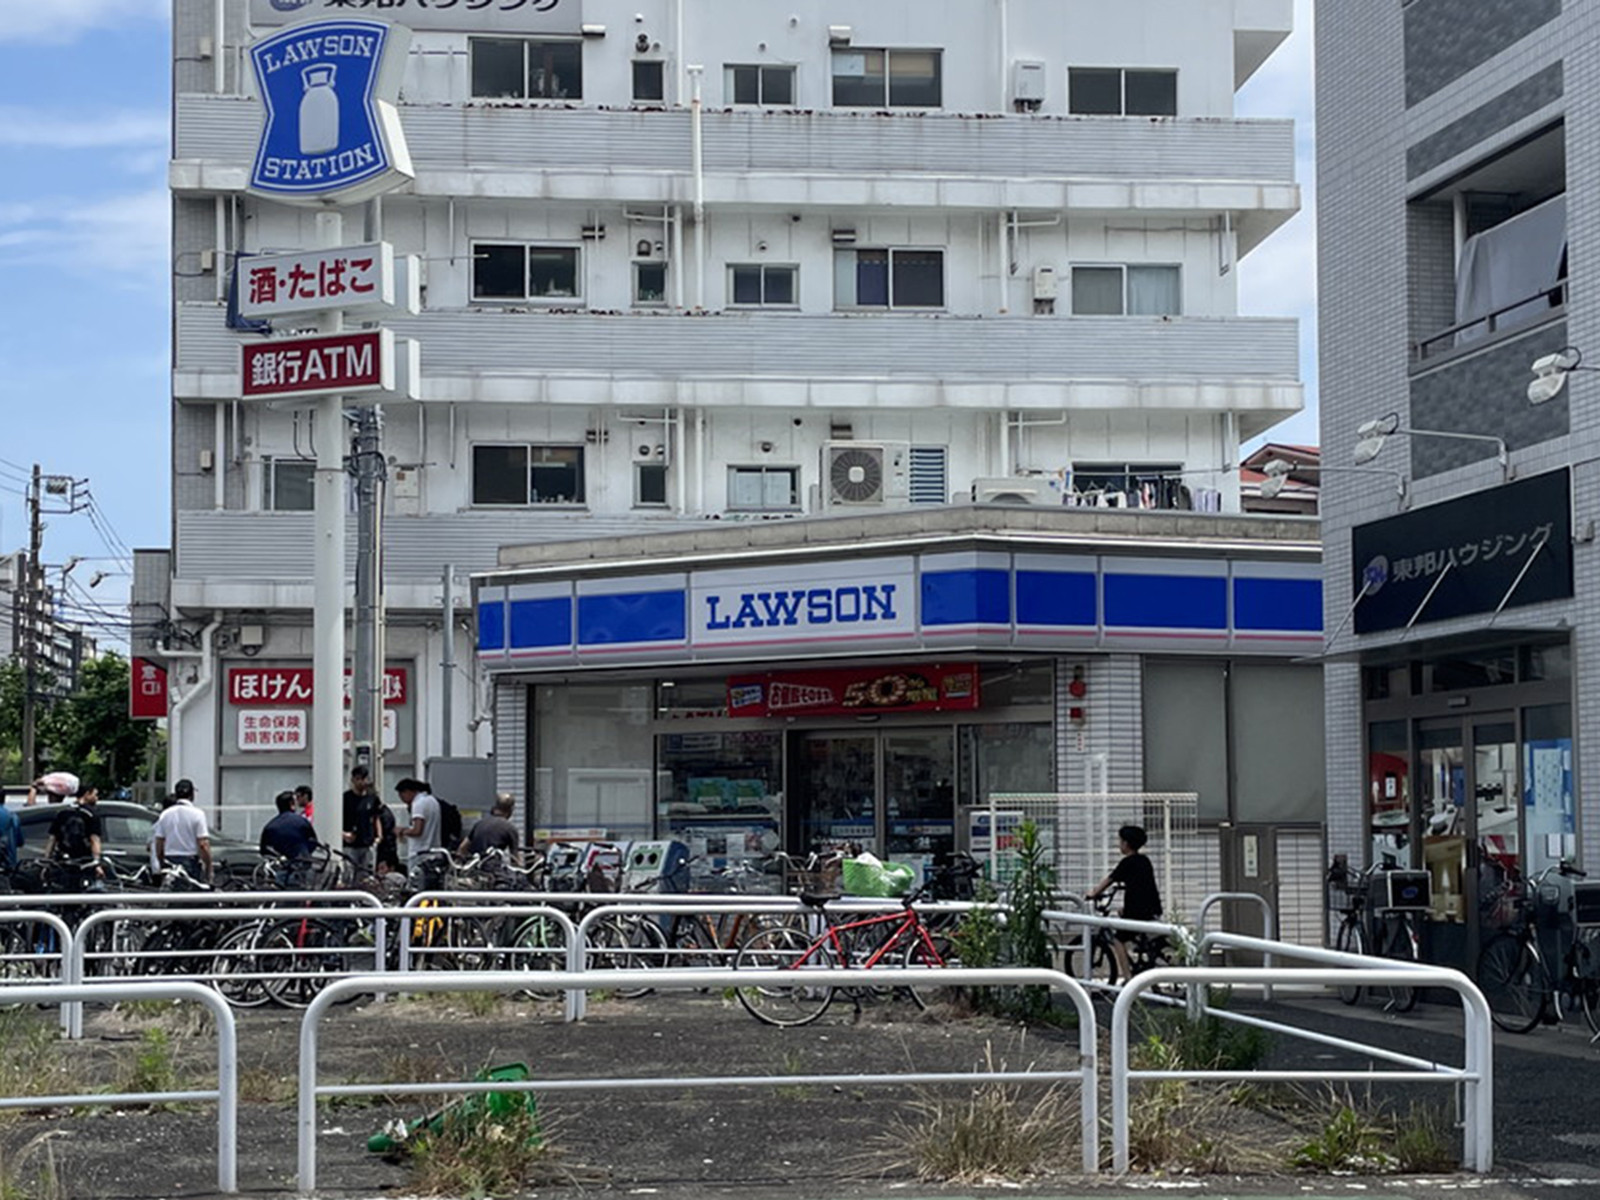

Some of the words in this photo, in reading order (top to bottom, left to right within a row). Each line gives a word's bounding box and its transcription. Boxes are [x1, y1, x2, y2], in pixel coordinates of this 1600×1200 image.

[264, 34, 374, 74] LAWSON
[264, 143, 374, 179] STATION
[249, 258, 374, 304] 酒・たばこ
[252, 344, 372, 387] 銀行ATM
[1392, 523, 1553, 582] 東邦ハウジング
[706, 584, 896, 630] LAWSON
[244, 716, 300, 729] 生命保険
[244, 731, 300, 744] 損害保険
